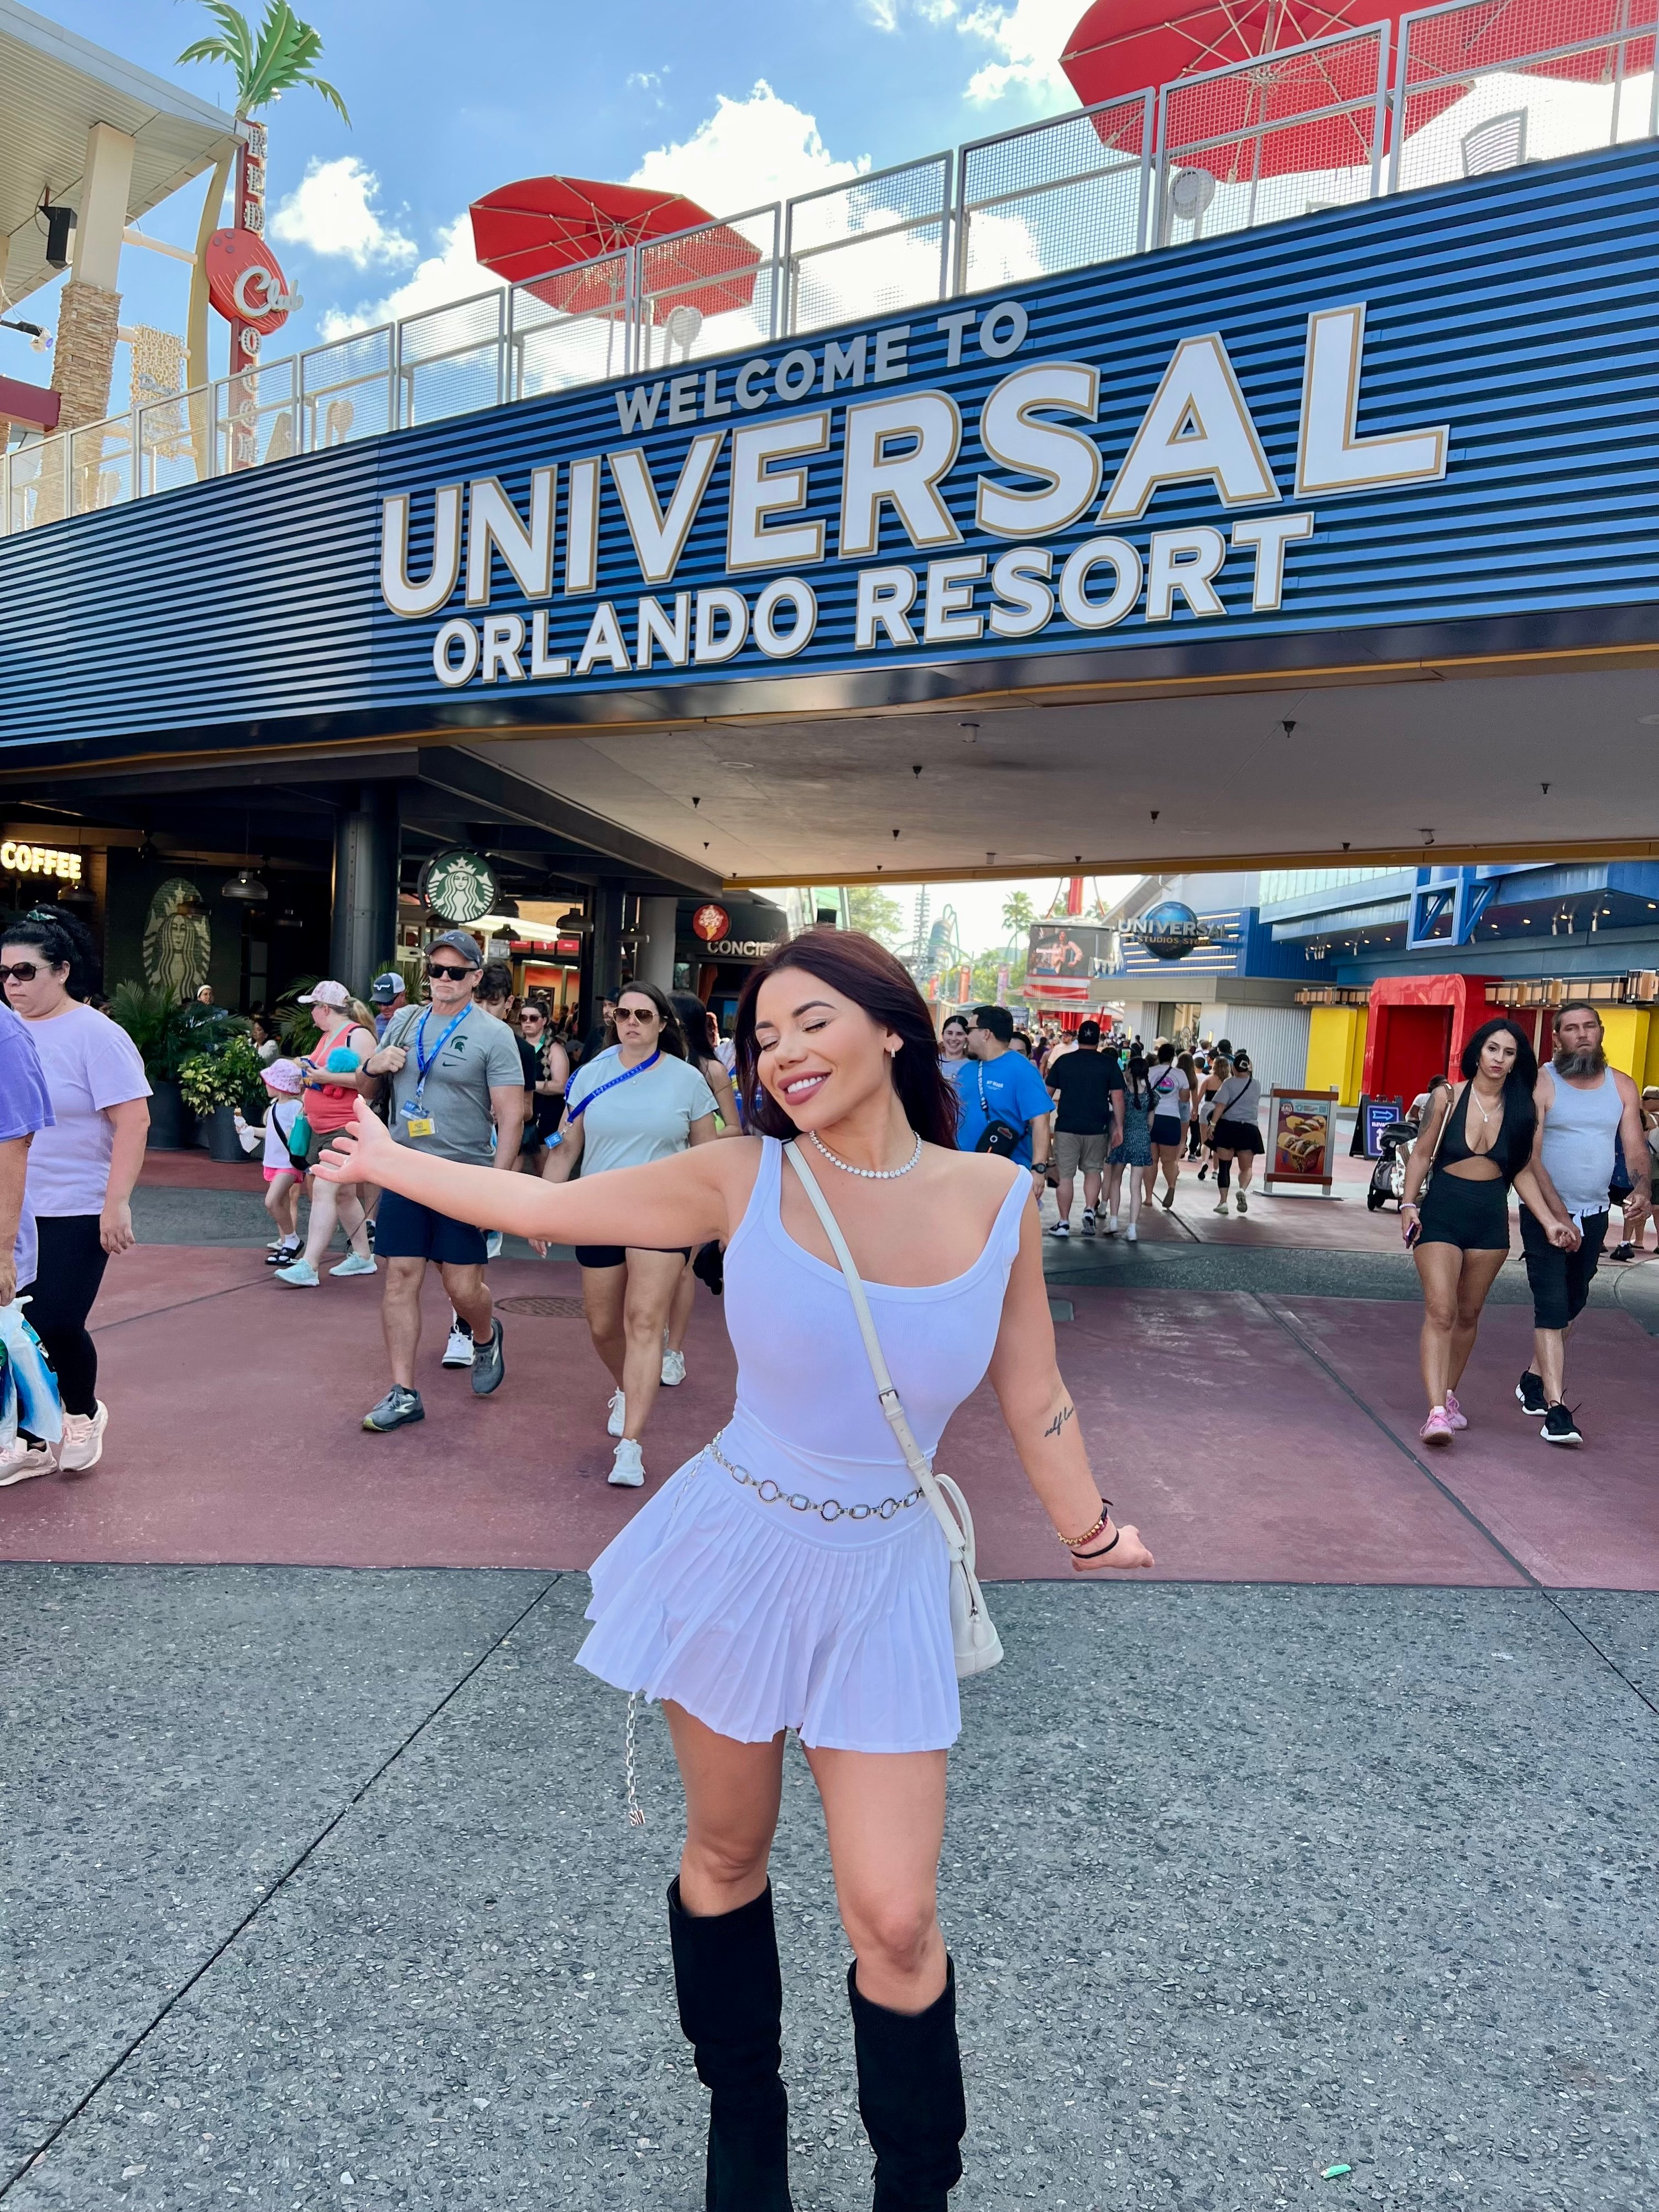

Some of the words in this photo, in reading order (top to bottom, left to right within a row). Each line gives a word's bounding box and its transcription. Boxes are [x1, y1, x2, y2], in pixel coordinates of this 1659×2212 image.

[247, 127, 268, 233] RED
[233, 265, 304, 319] Club
[614, 325, 911, 435] WELCOME
[937, 301, 1029, 368] TO
[380, 301, 1450, 619] UNIVERSAL
[432, 576, 818, 687] ORLANDO
[854, 511, 1314, 651] RESORT
[1, 842, 82, 879] COFFEE
[707, 940, 779, 957] CONCIE
[1118, 918, 1225, 938] UNIVERSAL
[1138, 936, 1180, 944] STUDIOS
